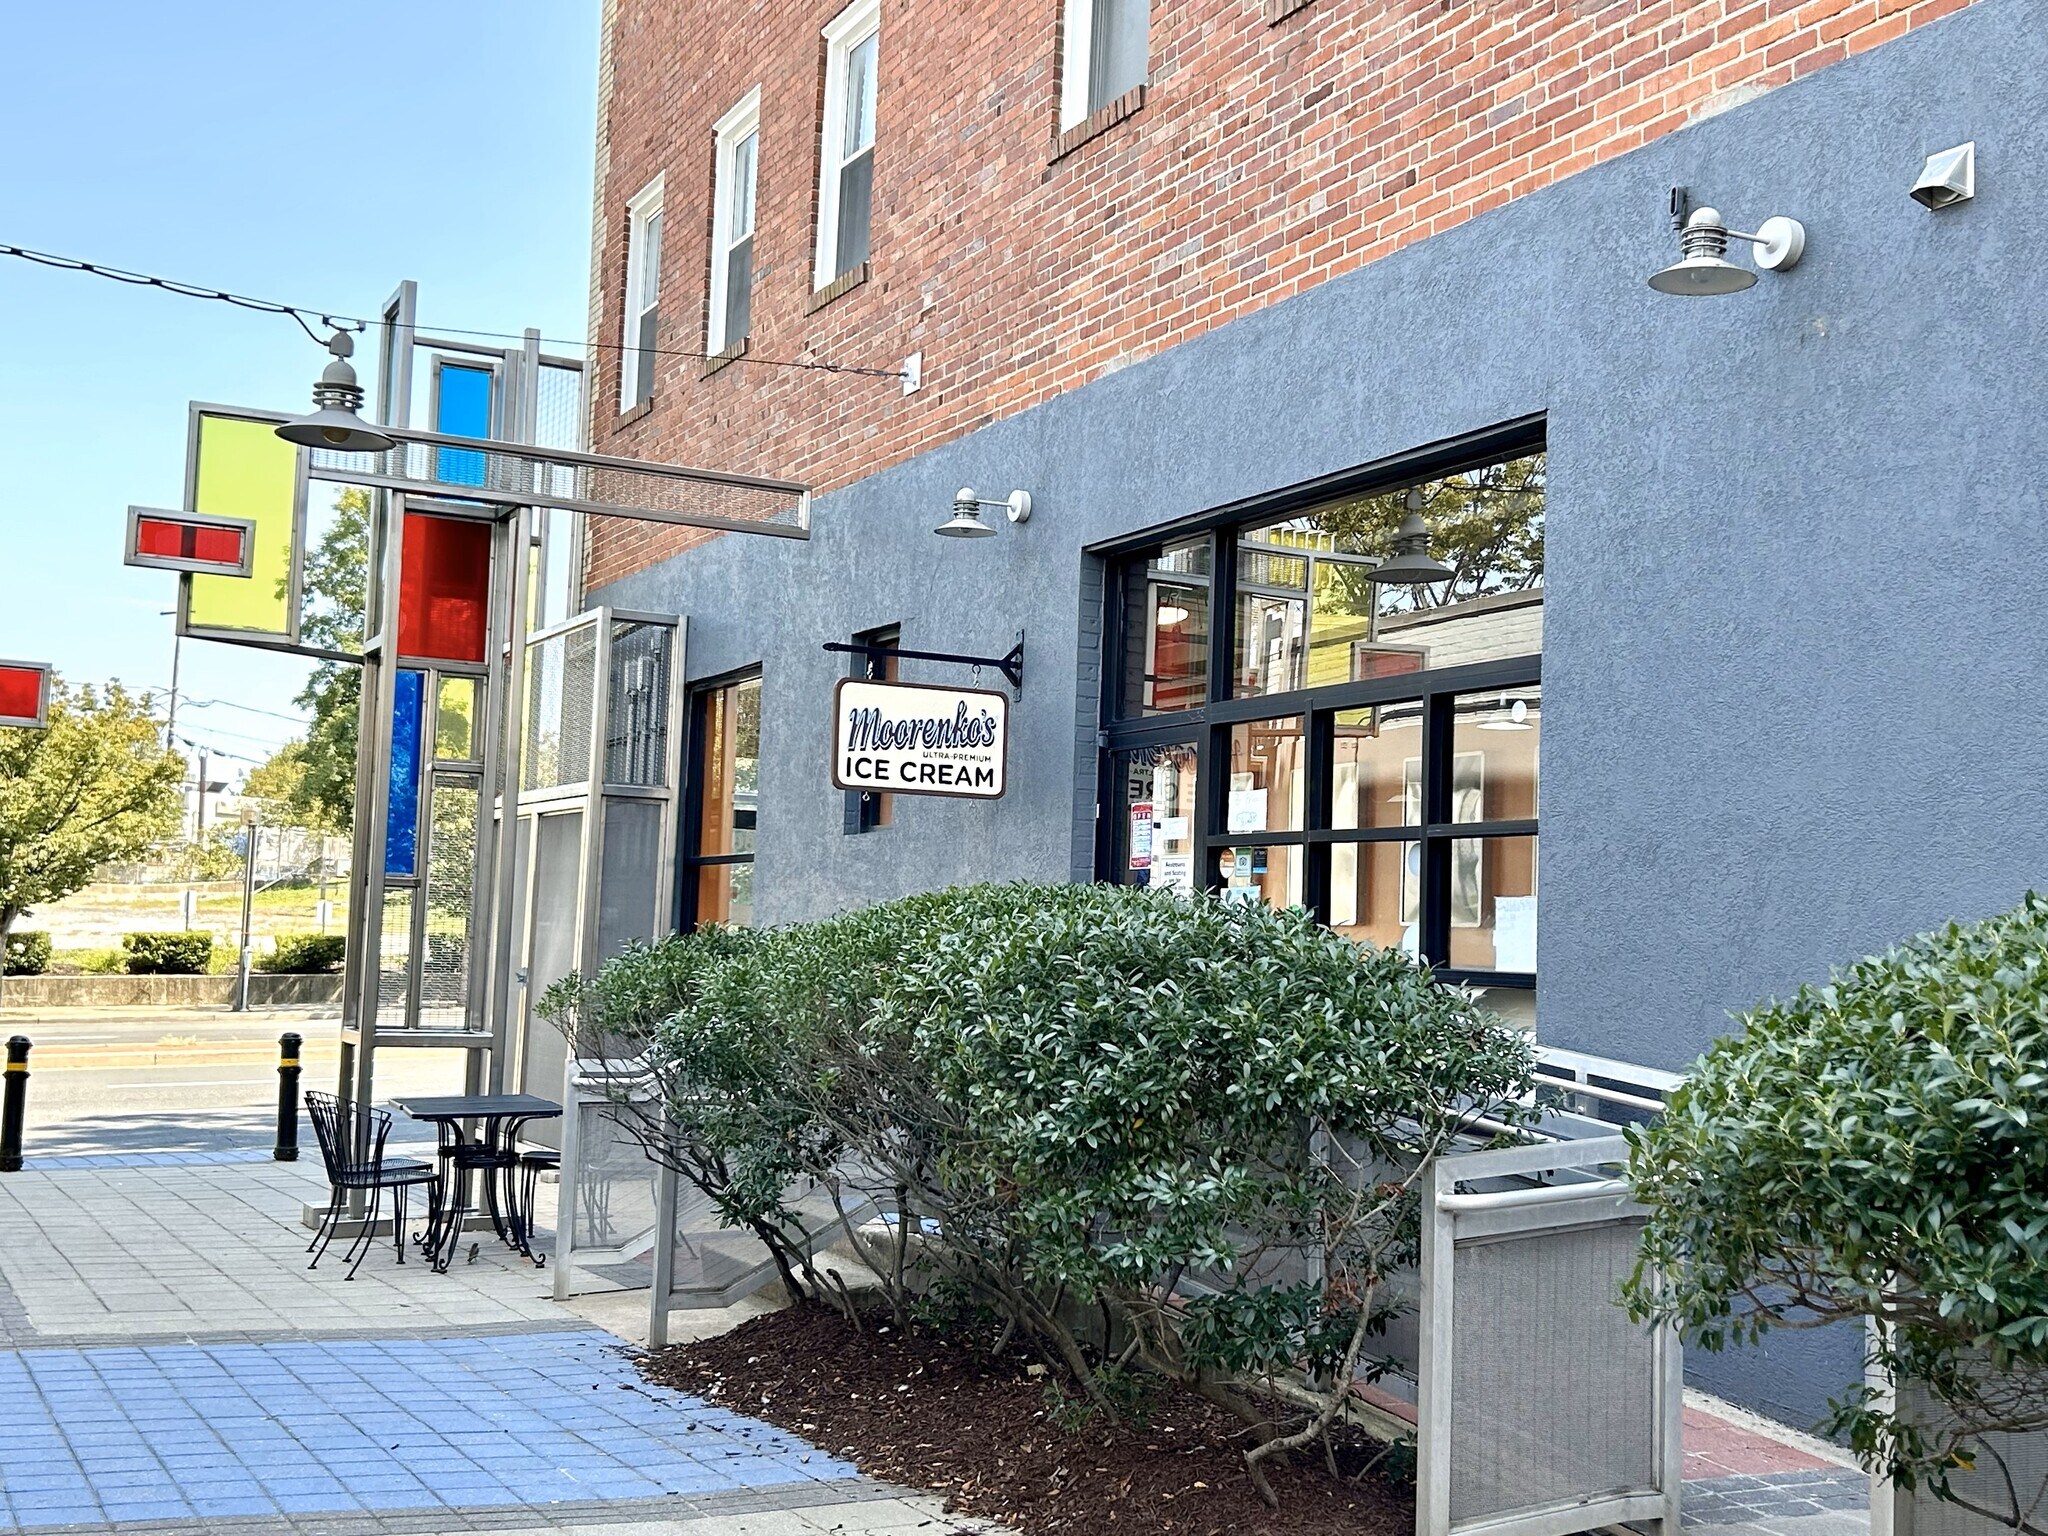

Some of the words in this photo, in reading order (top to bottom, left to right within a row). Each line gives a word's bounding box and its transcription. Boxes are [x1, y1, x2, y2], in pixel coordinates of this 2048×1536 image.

[848, 700, 996, 752] Moorenko's
[846, 756, 890, 780] ICE
[900, 761, 994, 788] CREAM
[922, 751, 992, 763] ULTRA-PREMIUM
